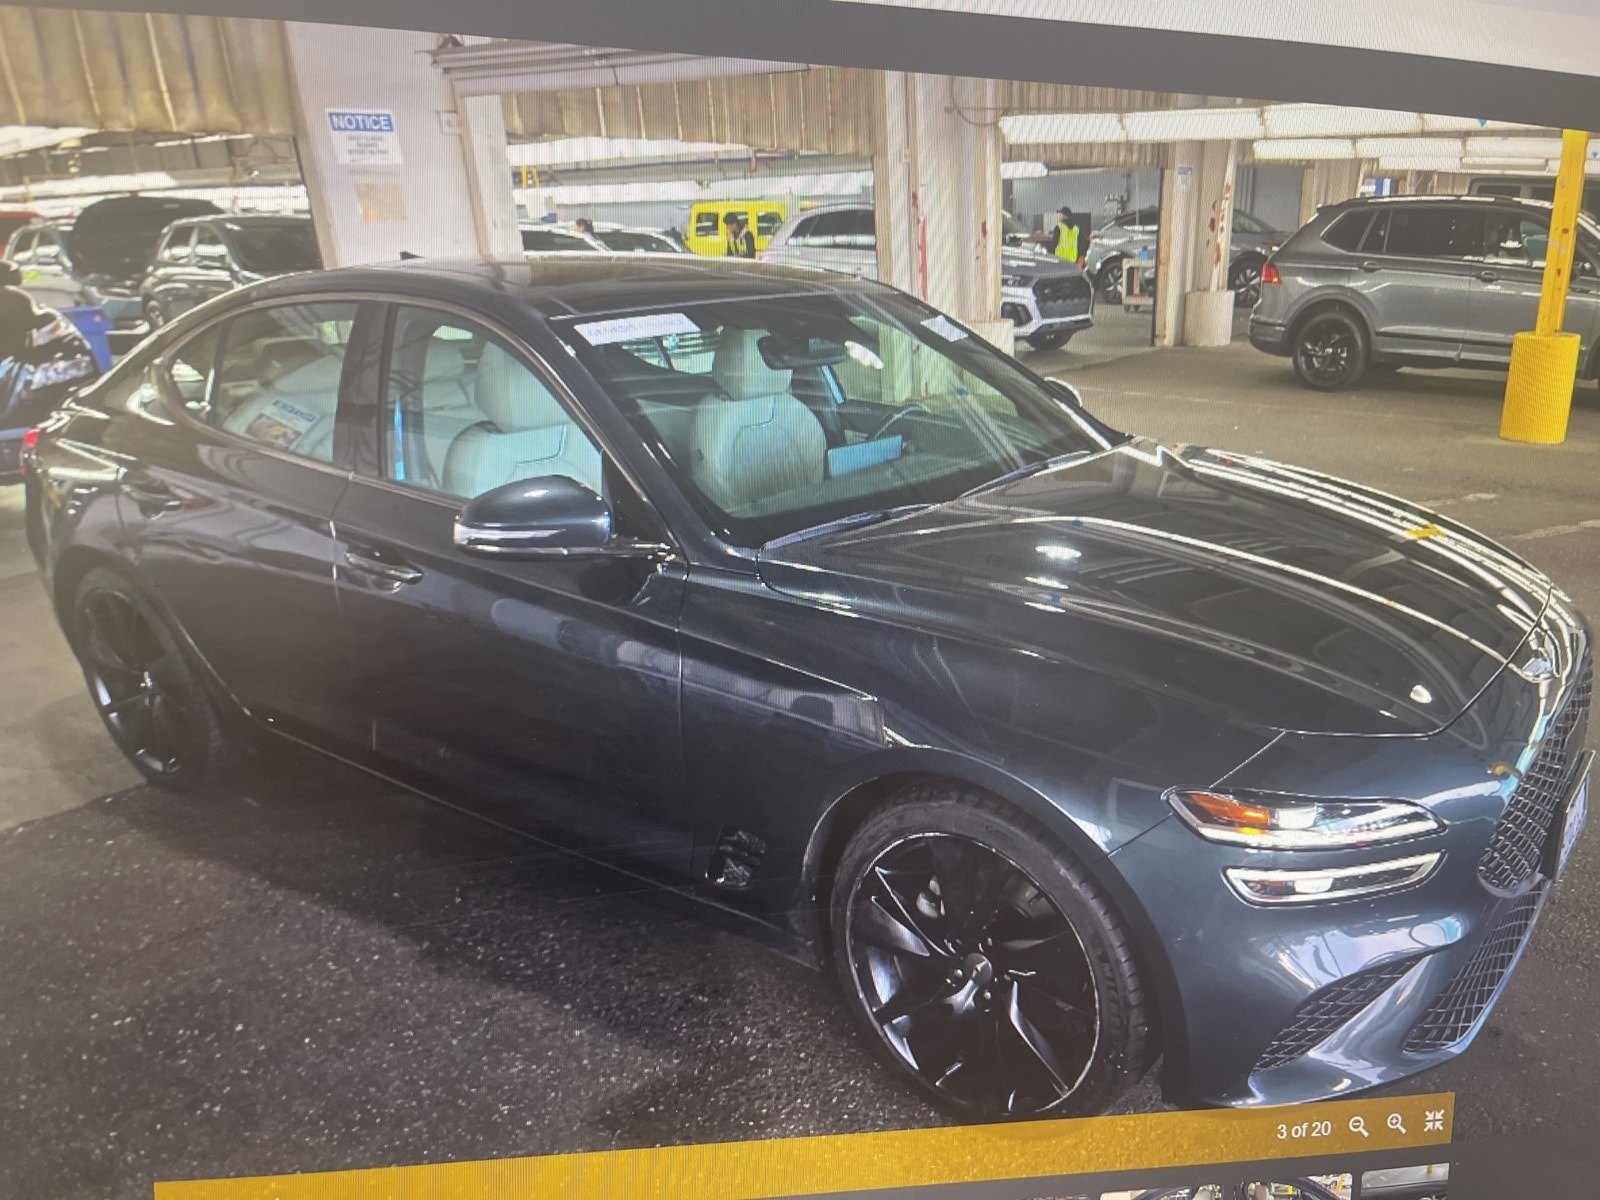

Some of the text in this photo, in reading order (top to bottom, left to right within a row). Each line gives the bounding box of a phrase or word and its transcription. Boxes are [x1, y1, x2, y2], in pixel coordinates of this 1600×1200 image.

[331, 114, 391, 130] NOTICE
[1276, 1120, 1332, 1139] 3 of 20
